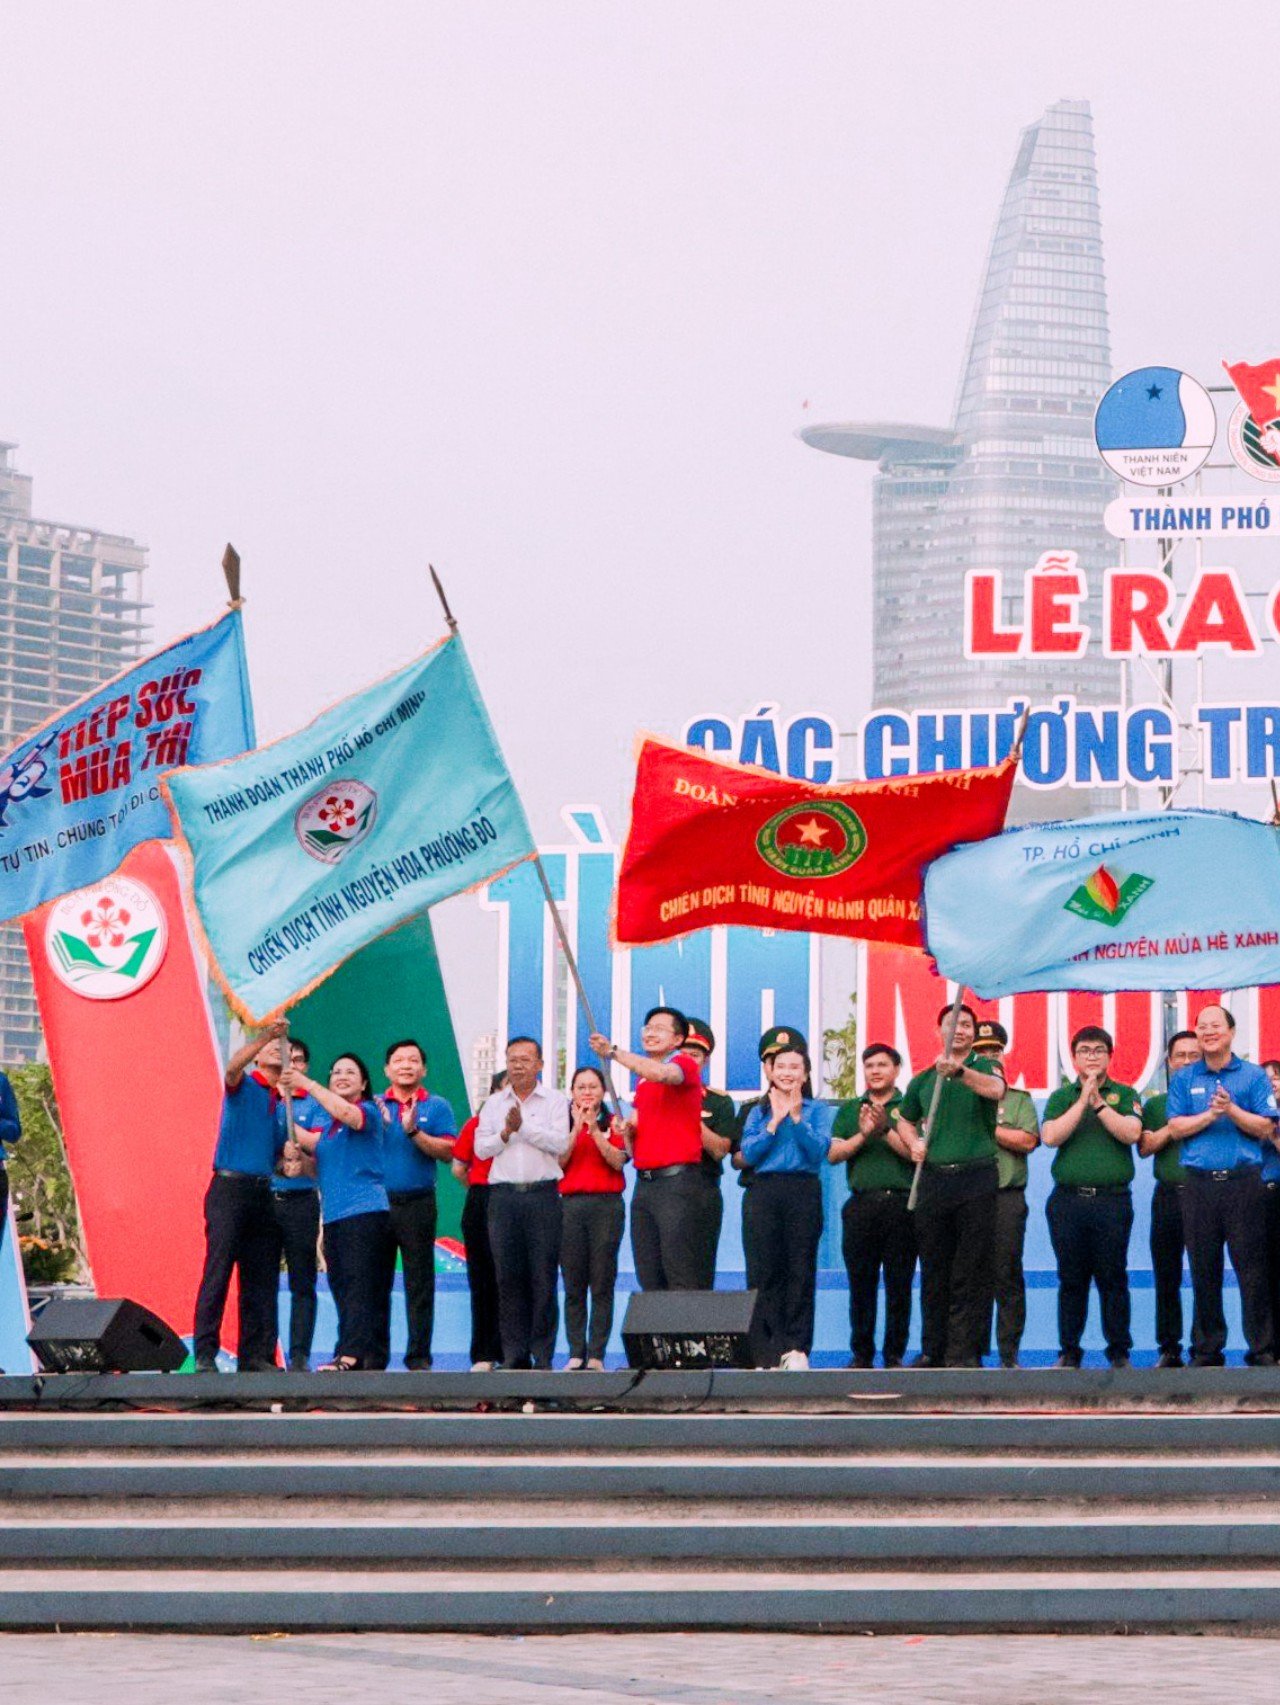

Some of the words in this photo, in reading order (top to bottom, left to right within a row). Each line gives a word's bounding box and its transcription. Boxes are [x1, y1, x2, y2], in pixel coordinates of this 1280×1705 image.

[1130, 467, 1152, 477] VIỆT
[1130, 503, 1211, 531] THÀNH
[1222, 498, 1270, 530] PHỐ
[971, 556, 1083, 653] LỄ
[1110, 573, 1255, 652] RA
[864, 701, 1172, 784] CHƯƠNG
[60, 741, 131, 804] MÙA
[203, 790, 249, 825] THÀNH
[247, 776, 286, 806] ĐOÀN
[281, 756, 326, 790] THÀNH
[328, 734, 354, 769] PHỐ
[353, 724, 374, 750] HỒ
[1022, 847, 1046, 861] TP.
[1053, 837, 1080, 859] HỒ
[248, 928, 290, 976] CHIẾN
[282, 912, 320, 951] DỊCH
[311, 892, 348, 930] TÌNH
[340, 864, 399, 913] NGUYỆN
[393, 851, 426, 886] HOA
[419, 826, 477, 872] PHƯỢNG
[471, 806, 498, 846] ĐỎ
[702, 884, 735, 914] DỊCH
[739, 879, 770, 907] TÌNH
[773, 889, 824, 919] NGUYỆN
[827, 897, 865, 920] HÀNH
[868, 893, 906, 922] QUÂN
[1165, 933, 1202, 955] MÙA
[1207, 930, 1229, 950] HÈ
[1235, 931, 1279, 948] XANH
